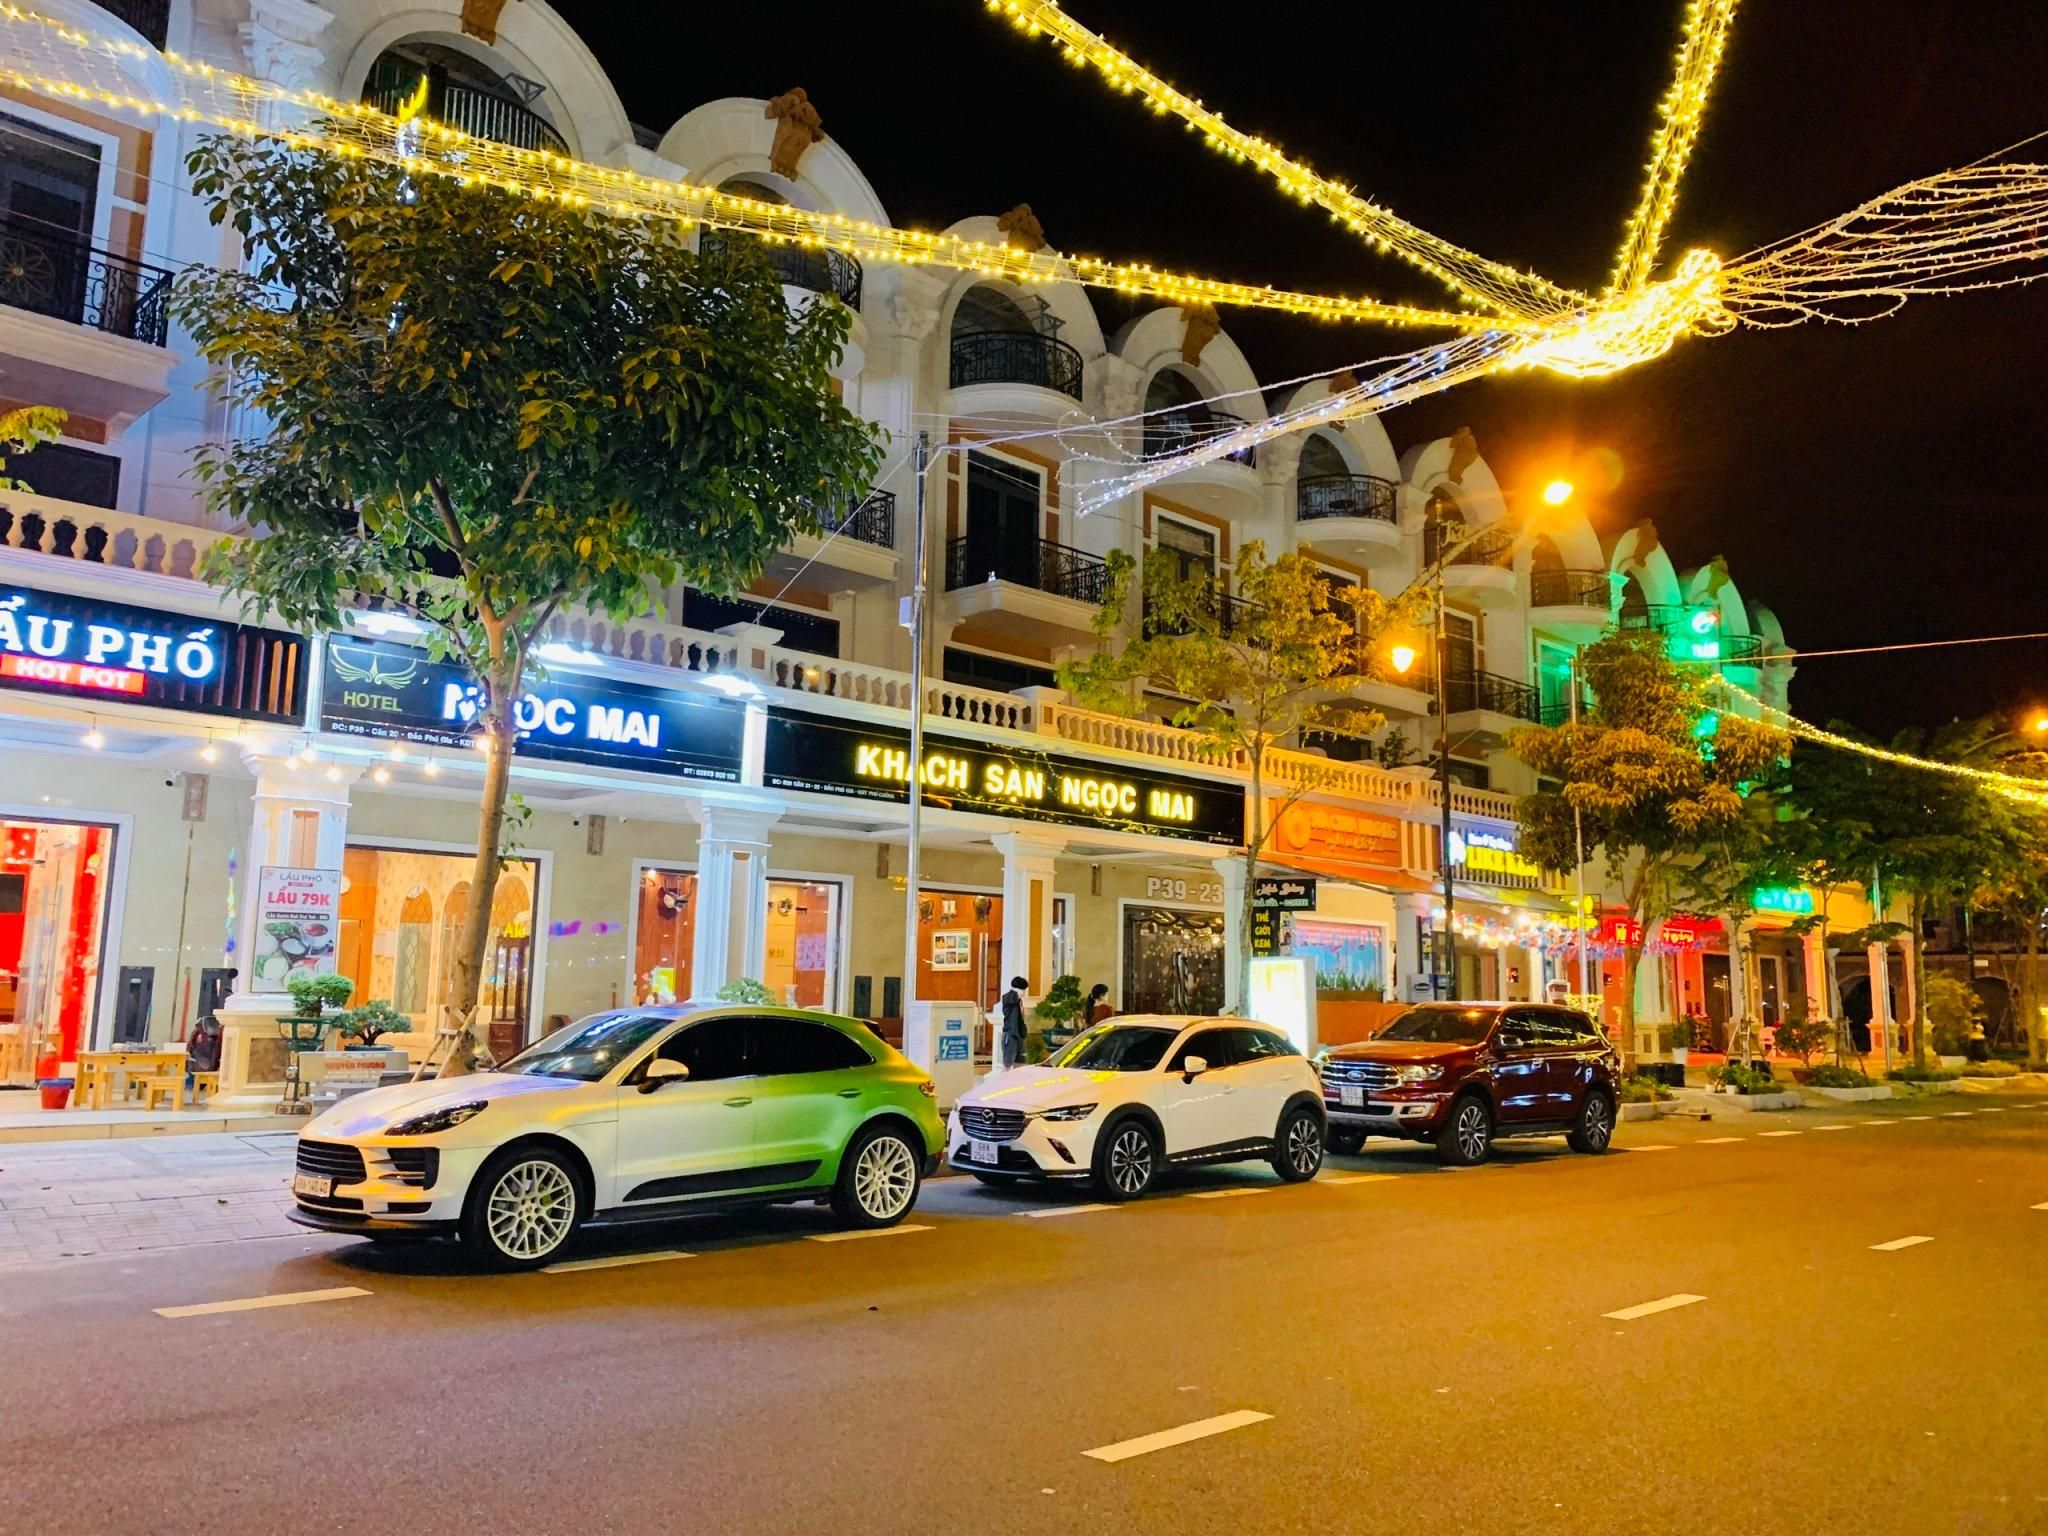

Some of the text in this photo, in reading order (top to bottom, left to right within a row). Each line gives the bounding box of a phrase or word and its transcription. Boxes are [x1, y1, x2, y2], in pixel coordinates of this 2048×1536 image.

[85, 625, 214, 679] PHỐ
[16, 658, 130, 690] HOT POT
[343, 690, 403, 712] HOTEL
[443, 683, 660, 748] NỌC MAI
[984, 763, 1045, 802] SẠN
[1062, 777, 1137, 816] NGỌC
[1150, 789, 1194, 821] MAI
[267, 886, 330, 906] LẨU 79K
[1254, 939, 1271, 949] KEM
